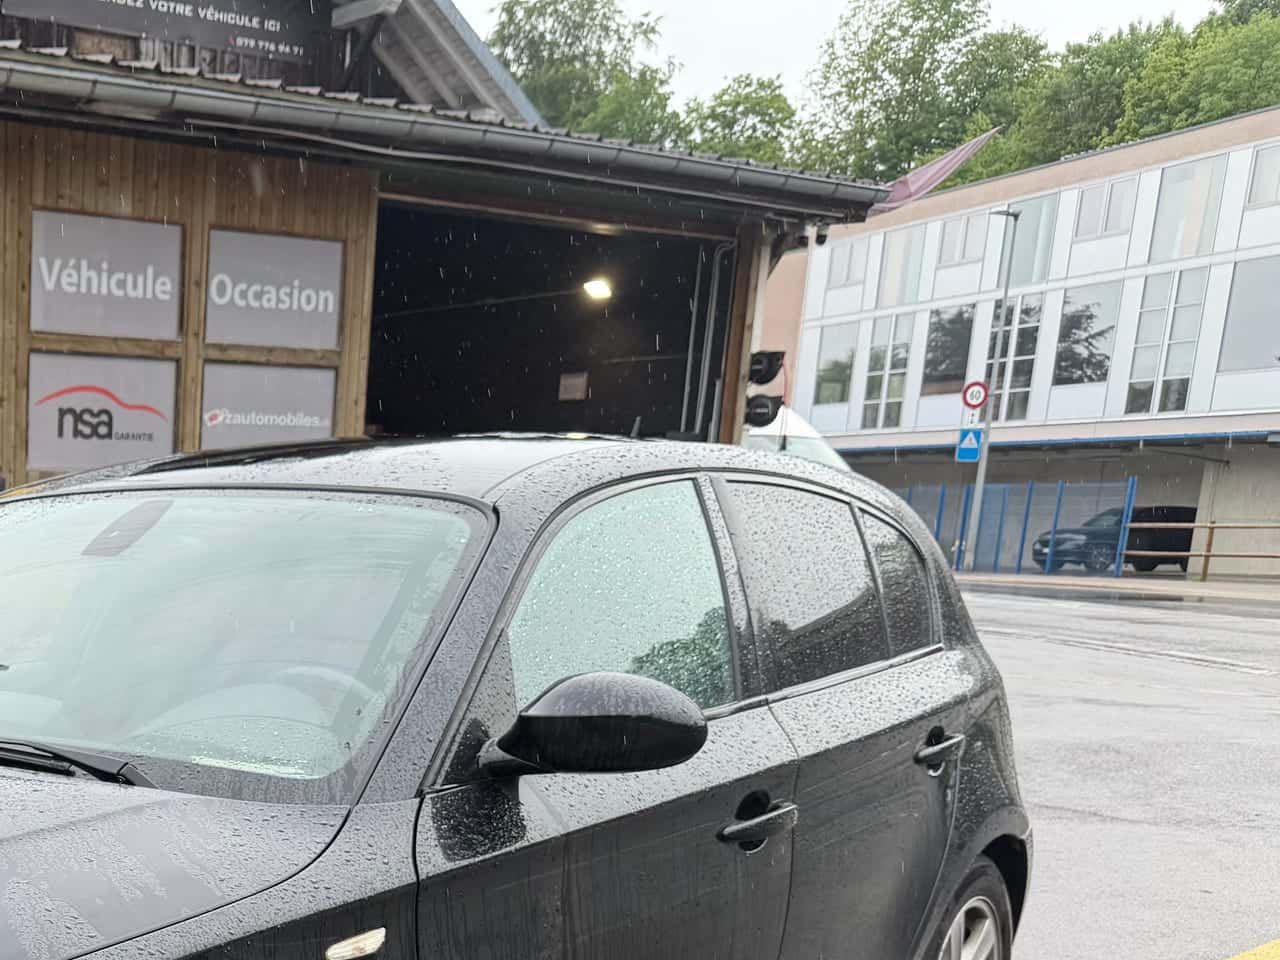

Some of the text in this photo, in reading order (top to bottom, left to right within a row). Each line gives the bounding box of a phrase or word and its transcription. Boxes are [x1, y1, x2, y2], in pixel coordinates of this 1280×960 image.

[149, 0, 193, 17] VOTRE
[263, 18, 281, 33] ICI
[39, 256, 172, 301] Véhicule
[210, 273, 334, 313] Occasion
[57, 407, 113, 440] nsa
